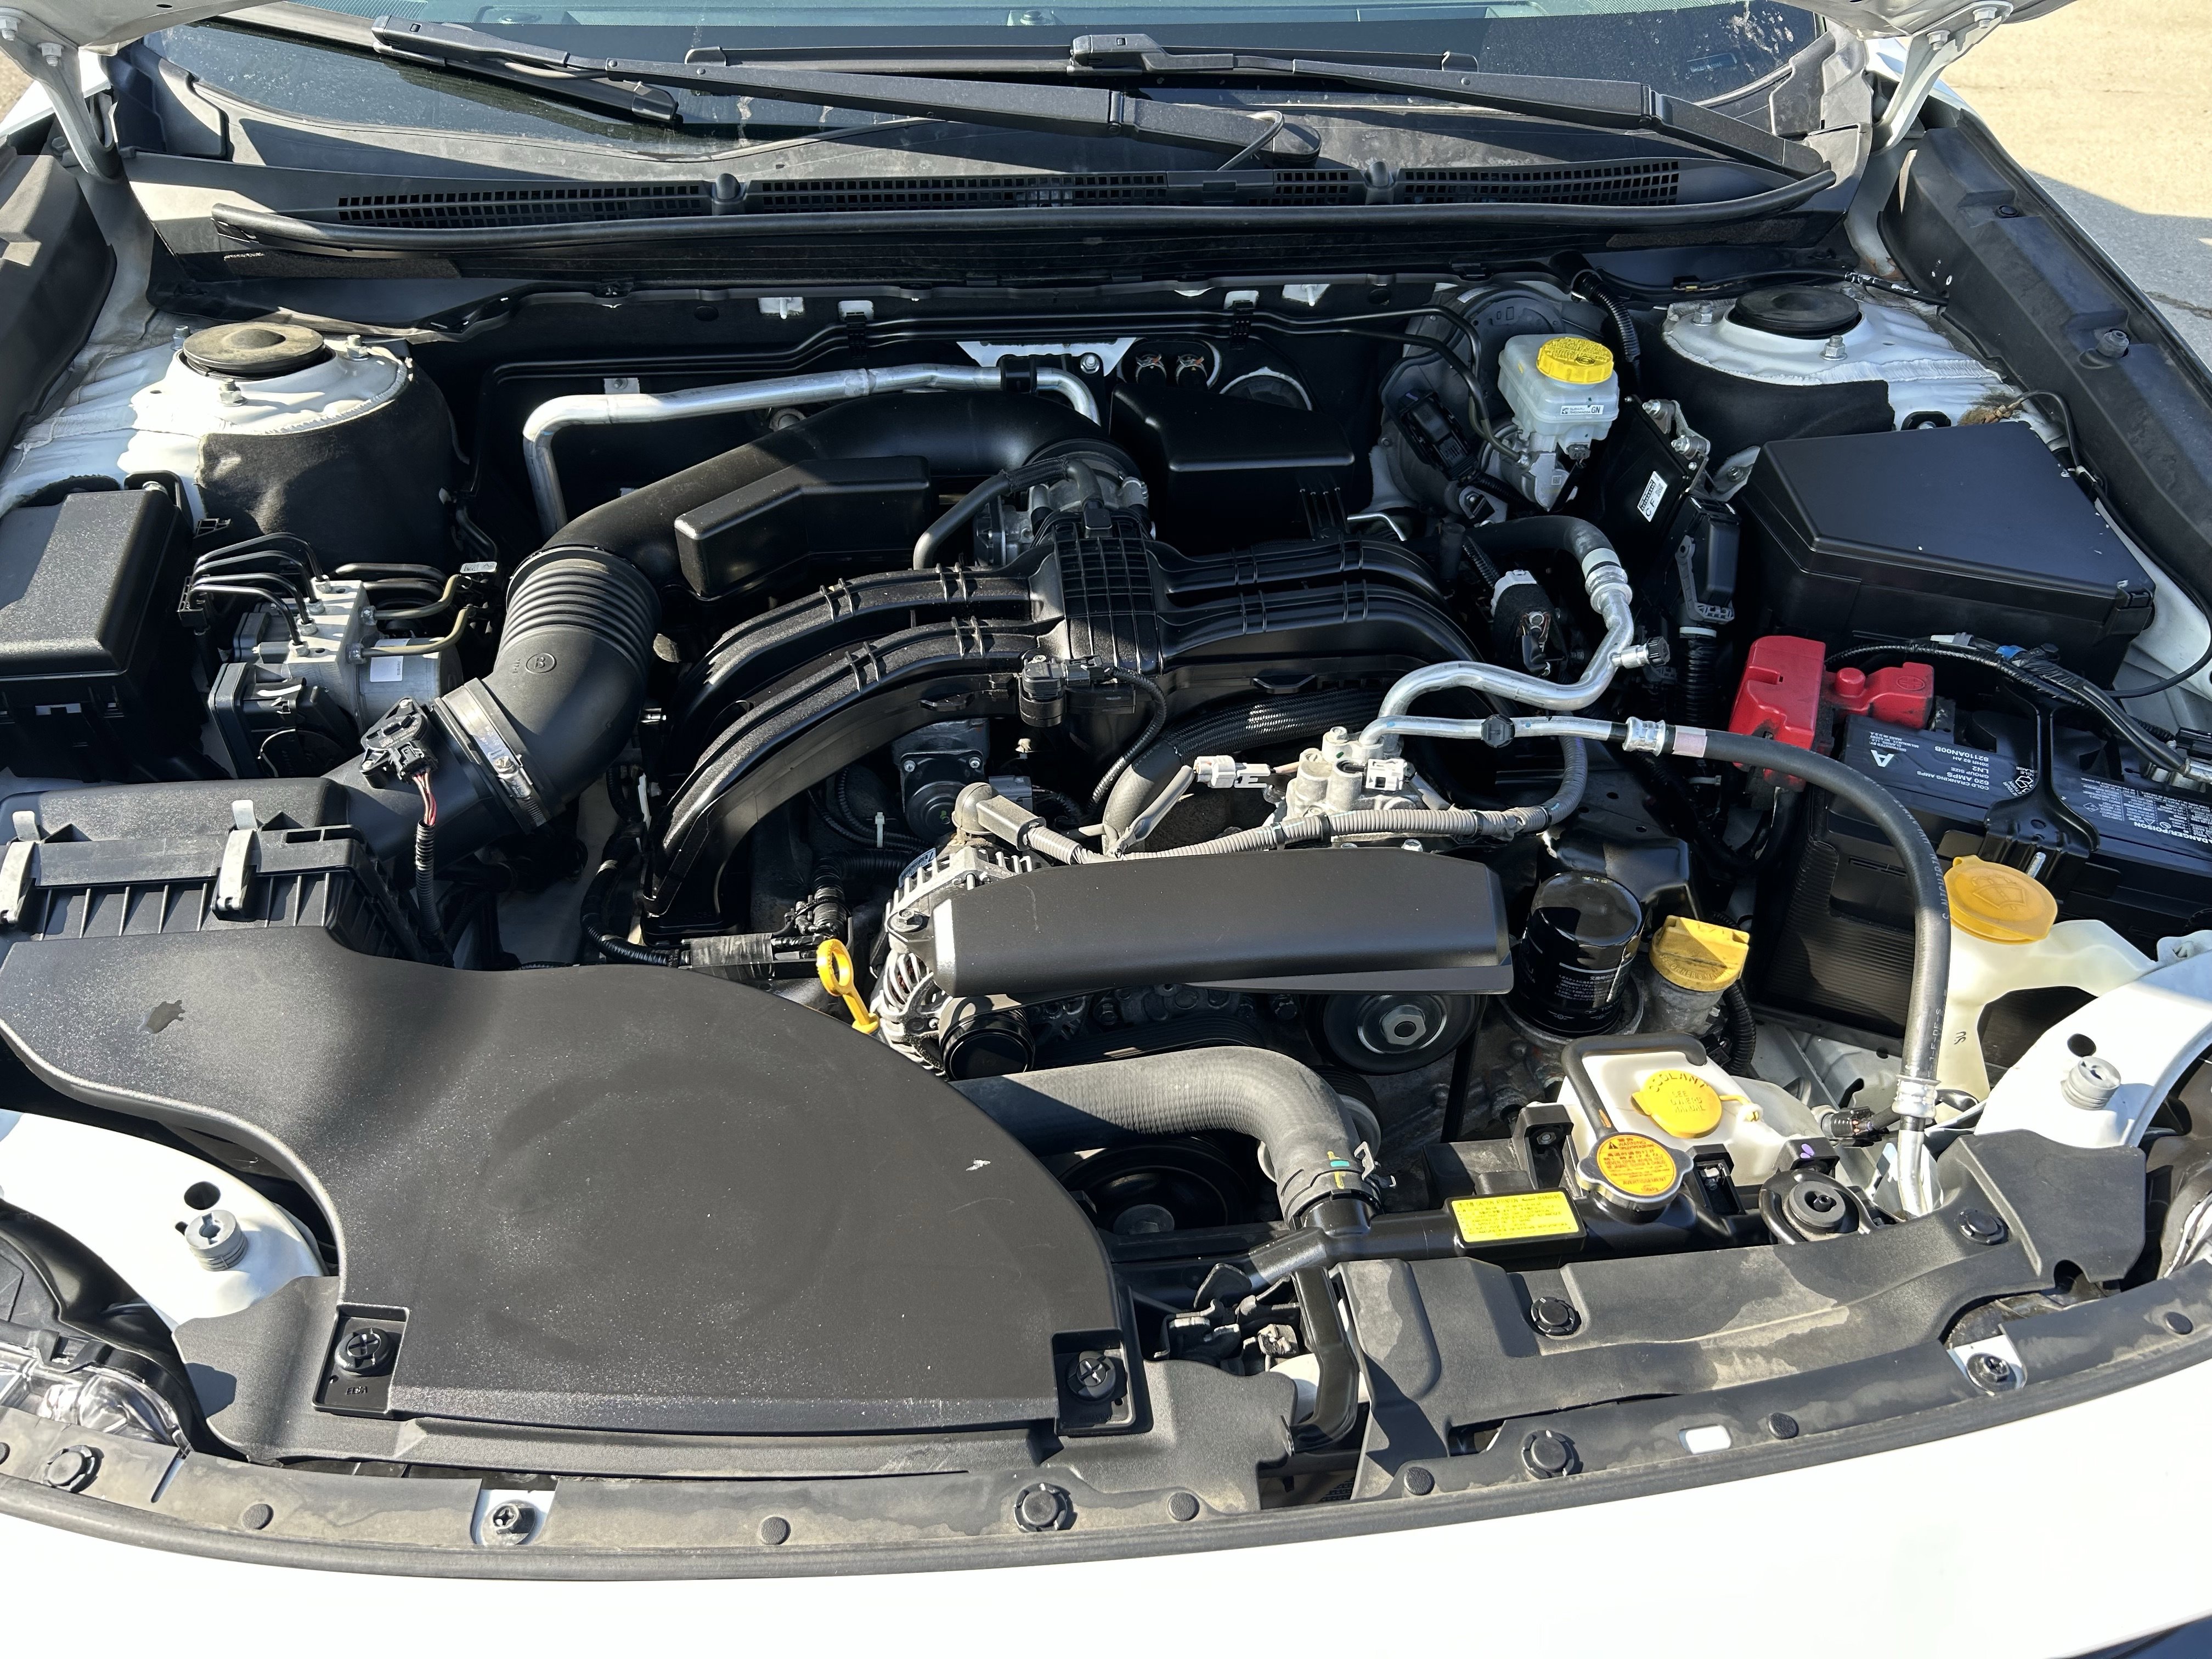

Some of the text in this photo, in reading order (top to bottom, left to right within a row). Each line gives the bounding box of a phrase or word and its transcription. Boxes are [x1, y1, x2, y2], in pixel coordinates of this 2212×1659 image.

[533, 657, 546, 669] B
[1870, 749, 1894, 768] A
[1934, 746, 1989, 762] 82110AN00B
[1966, 771, 1989, 779] GROUP
[1972, 765, 1989, 774] LN2
[1936, 775, 1971, 786] CRANKING
[1946, 771, 1972, 781] AMPS
[1971, 782, 1989, 791] COLD
[2133, 821, 2209, 844] DANGER/POISON
[1649, 1072, 1708, 1092] COOLANT
